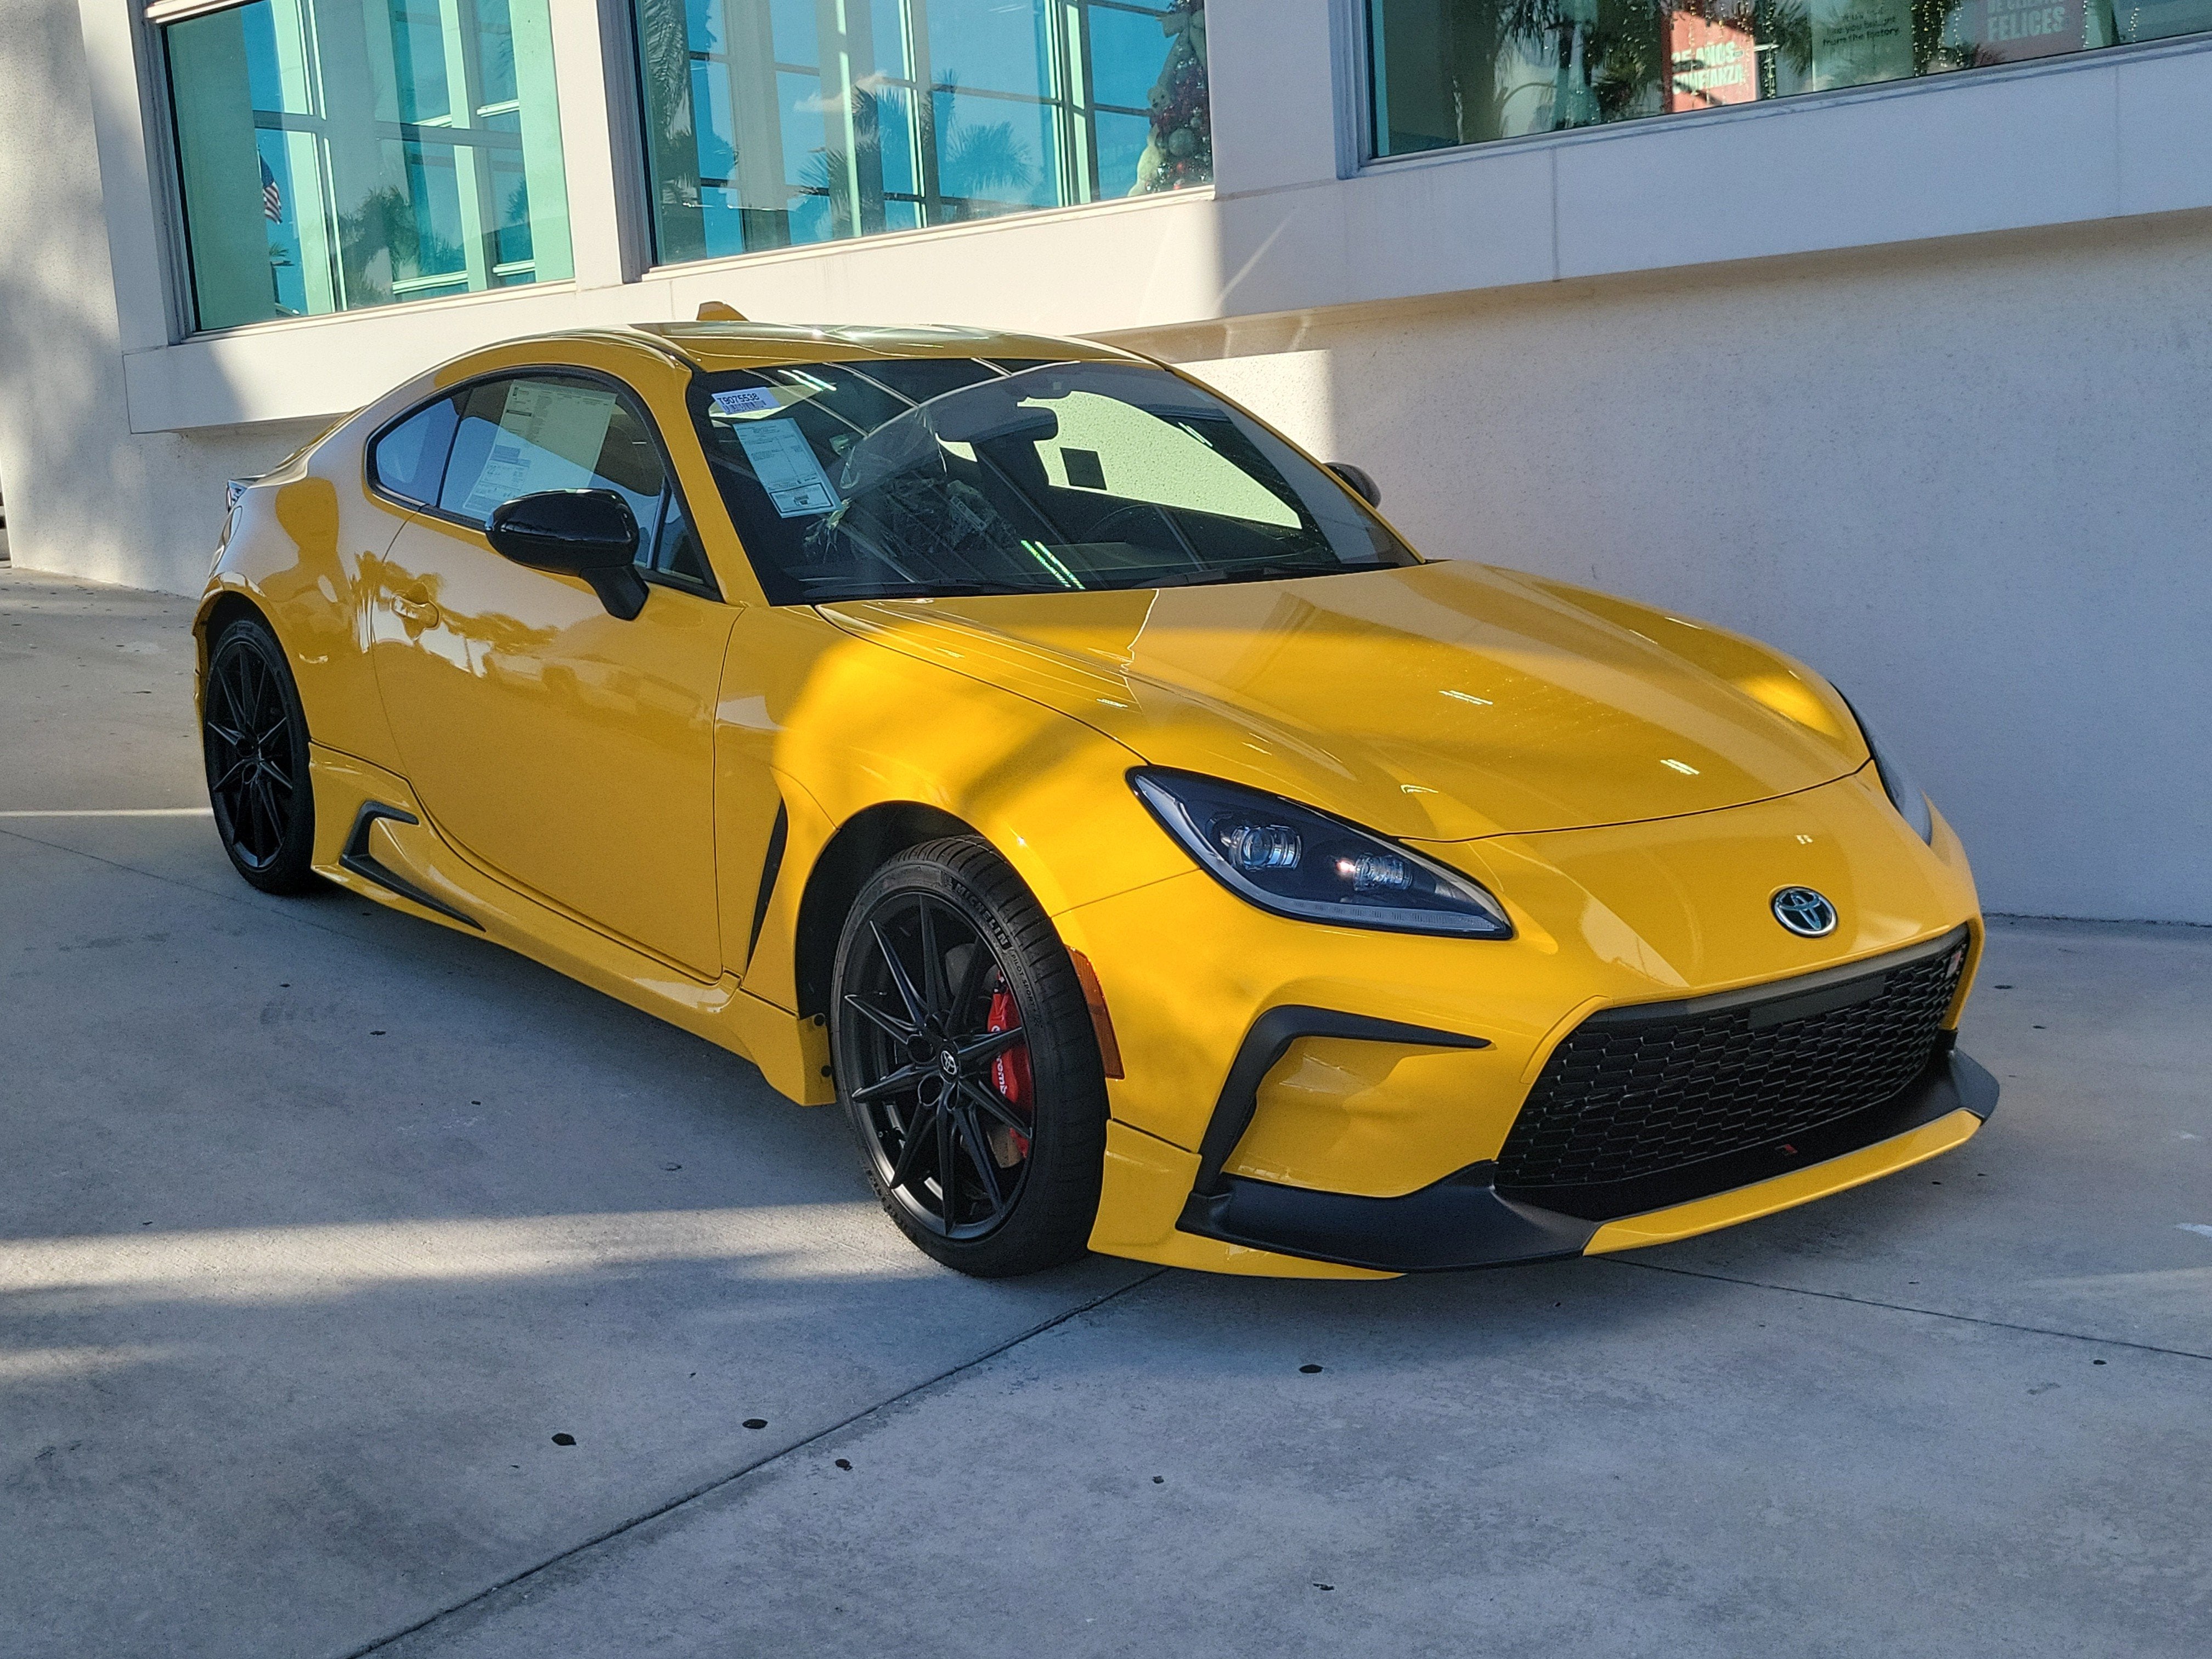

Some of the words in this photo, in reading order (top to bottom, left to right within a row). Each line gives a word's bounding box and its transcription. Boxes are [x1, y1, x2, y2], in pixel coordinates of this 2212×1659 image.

[1988, 7, 2066, 42] FELICES
[716, 393, 760, 405] T9075538
[956, 883, 1008, 947] MICHELIN
[1011, 953, 1024, 976] PILOT
[1022, 979, 1036, 1007] SPORT
